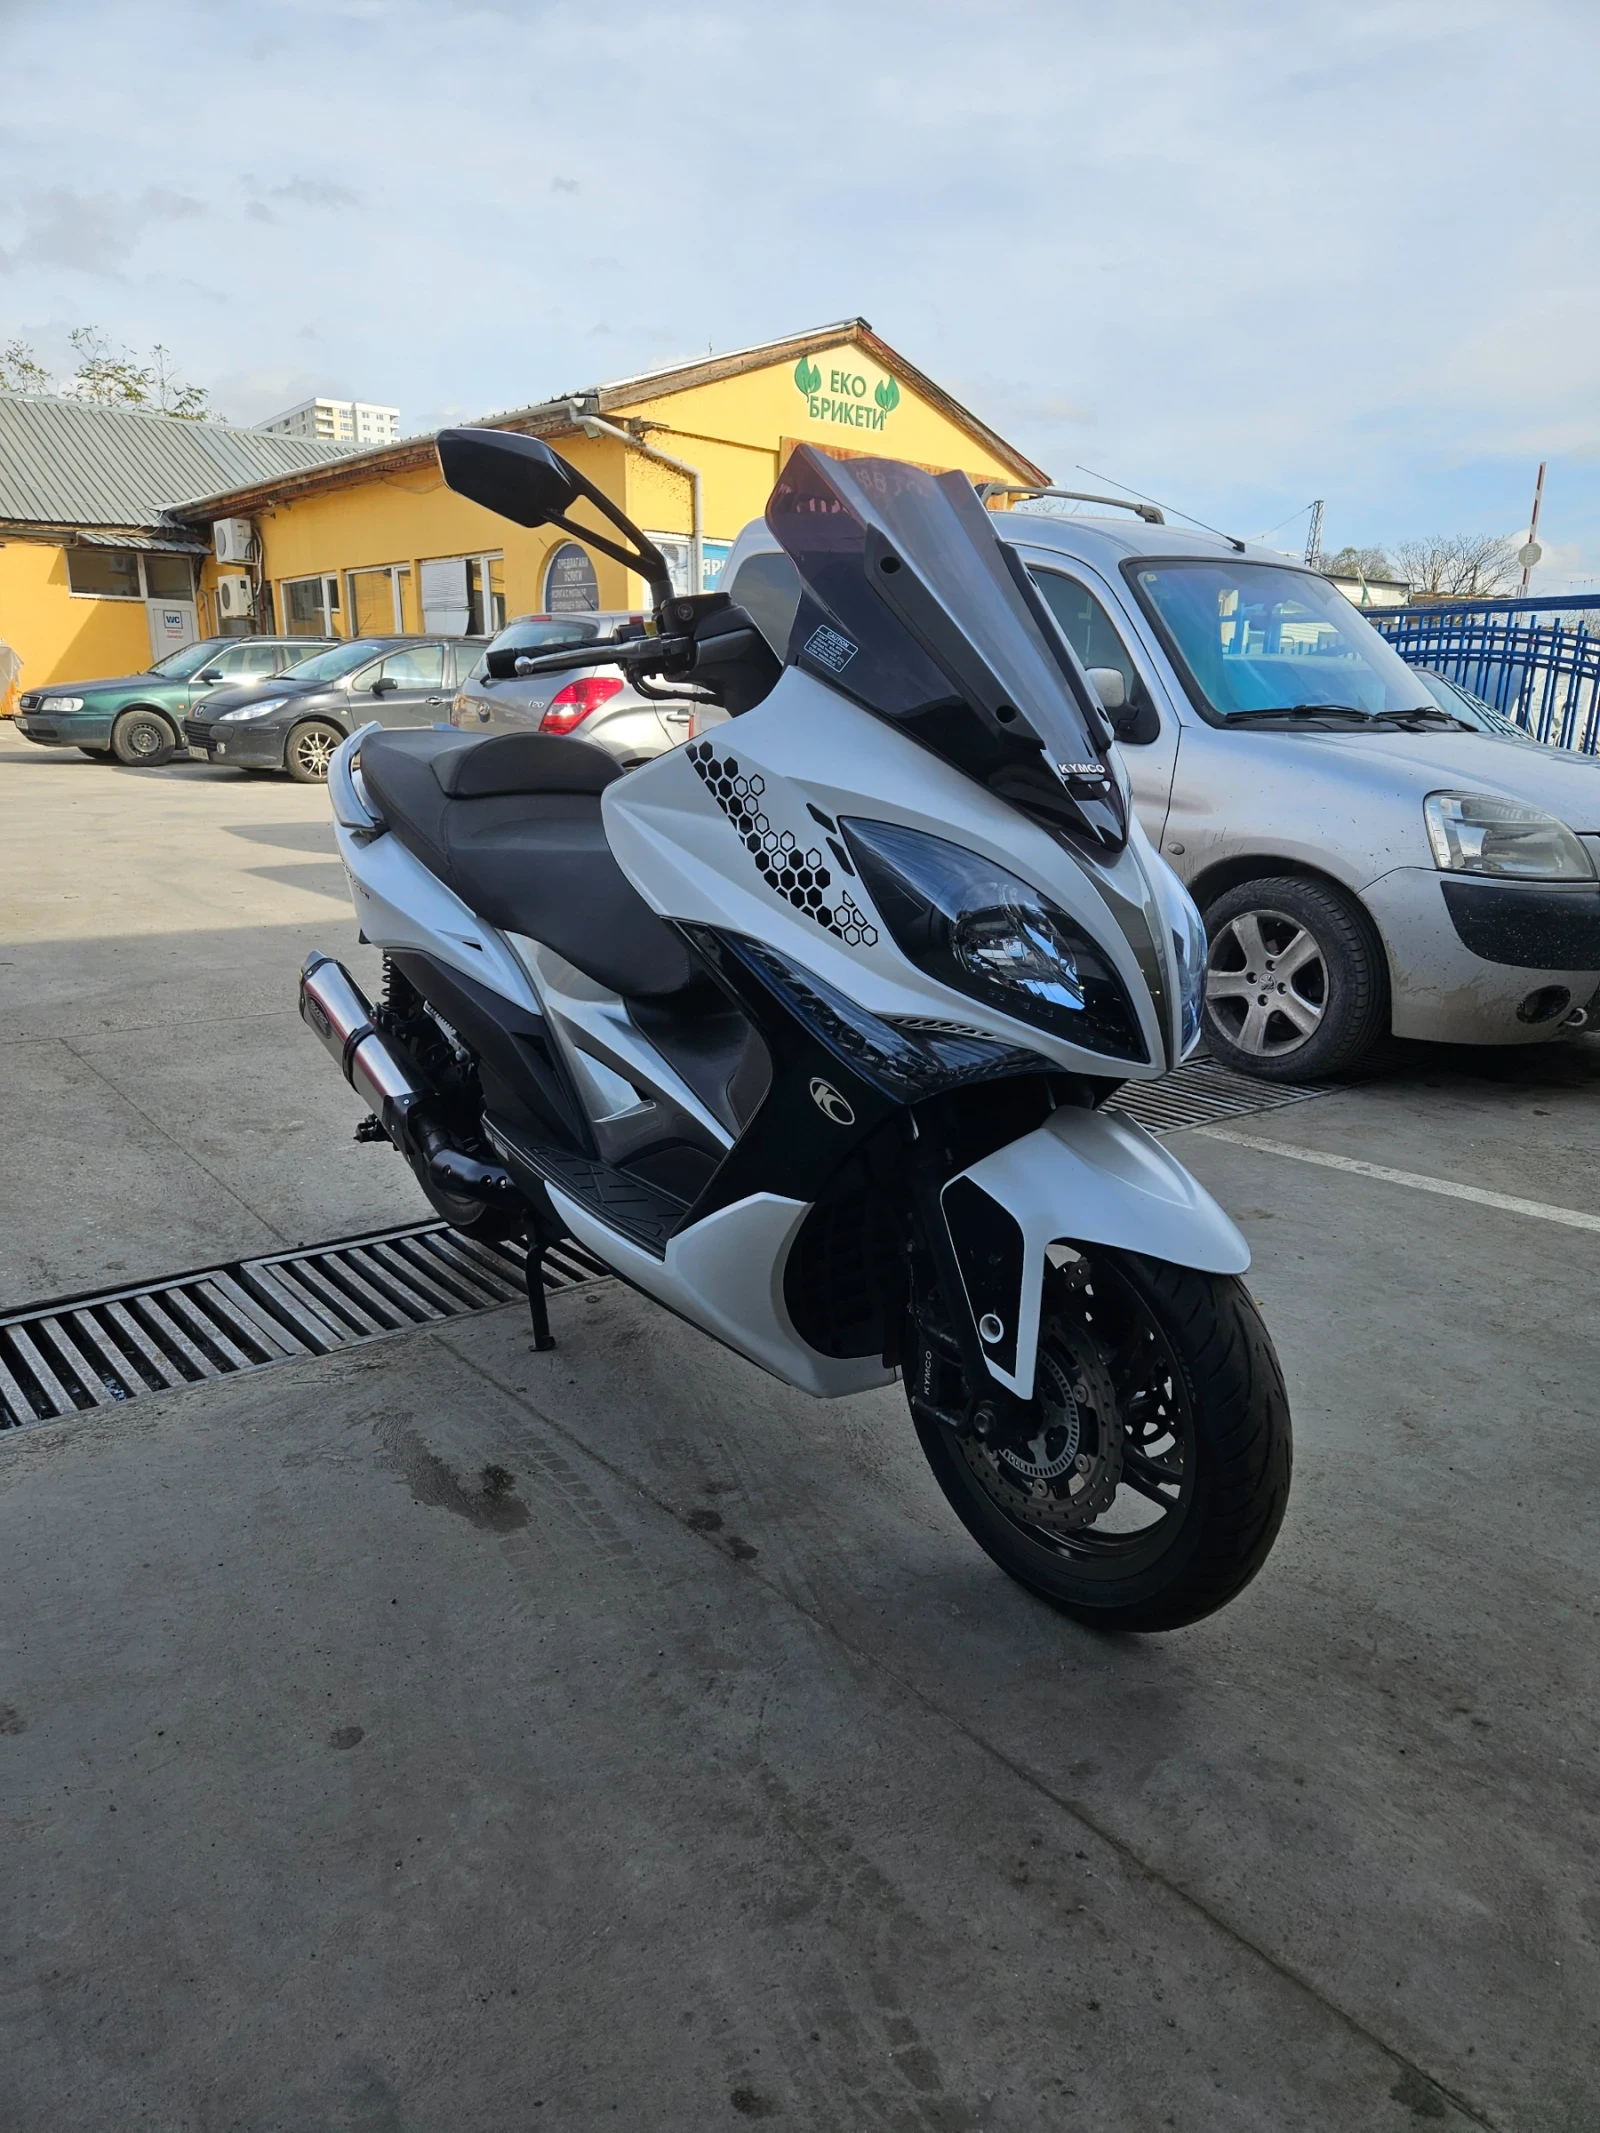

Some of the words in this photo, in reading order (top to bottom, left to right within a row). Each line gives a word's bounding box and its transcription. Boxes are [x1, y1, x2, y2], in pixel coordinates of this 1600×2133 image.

[830, 369, 867, 398] ЕКО
[809, 395, 884, 431] БРИКЕТИ
[166, 615, 181, 624] WC
[827, 632, 849, 648] CAUTION
[1057, 763, 1106, 774] KYMCO
[923, 1350, 932, 1396] KYMCO
